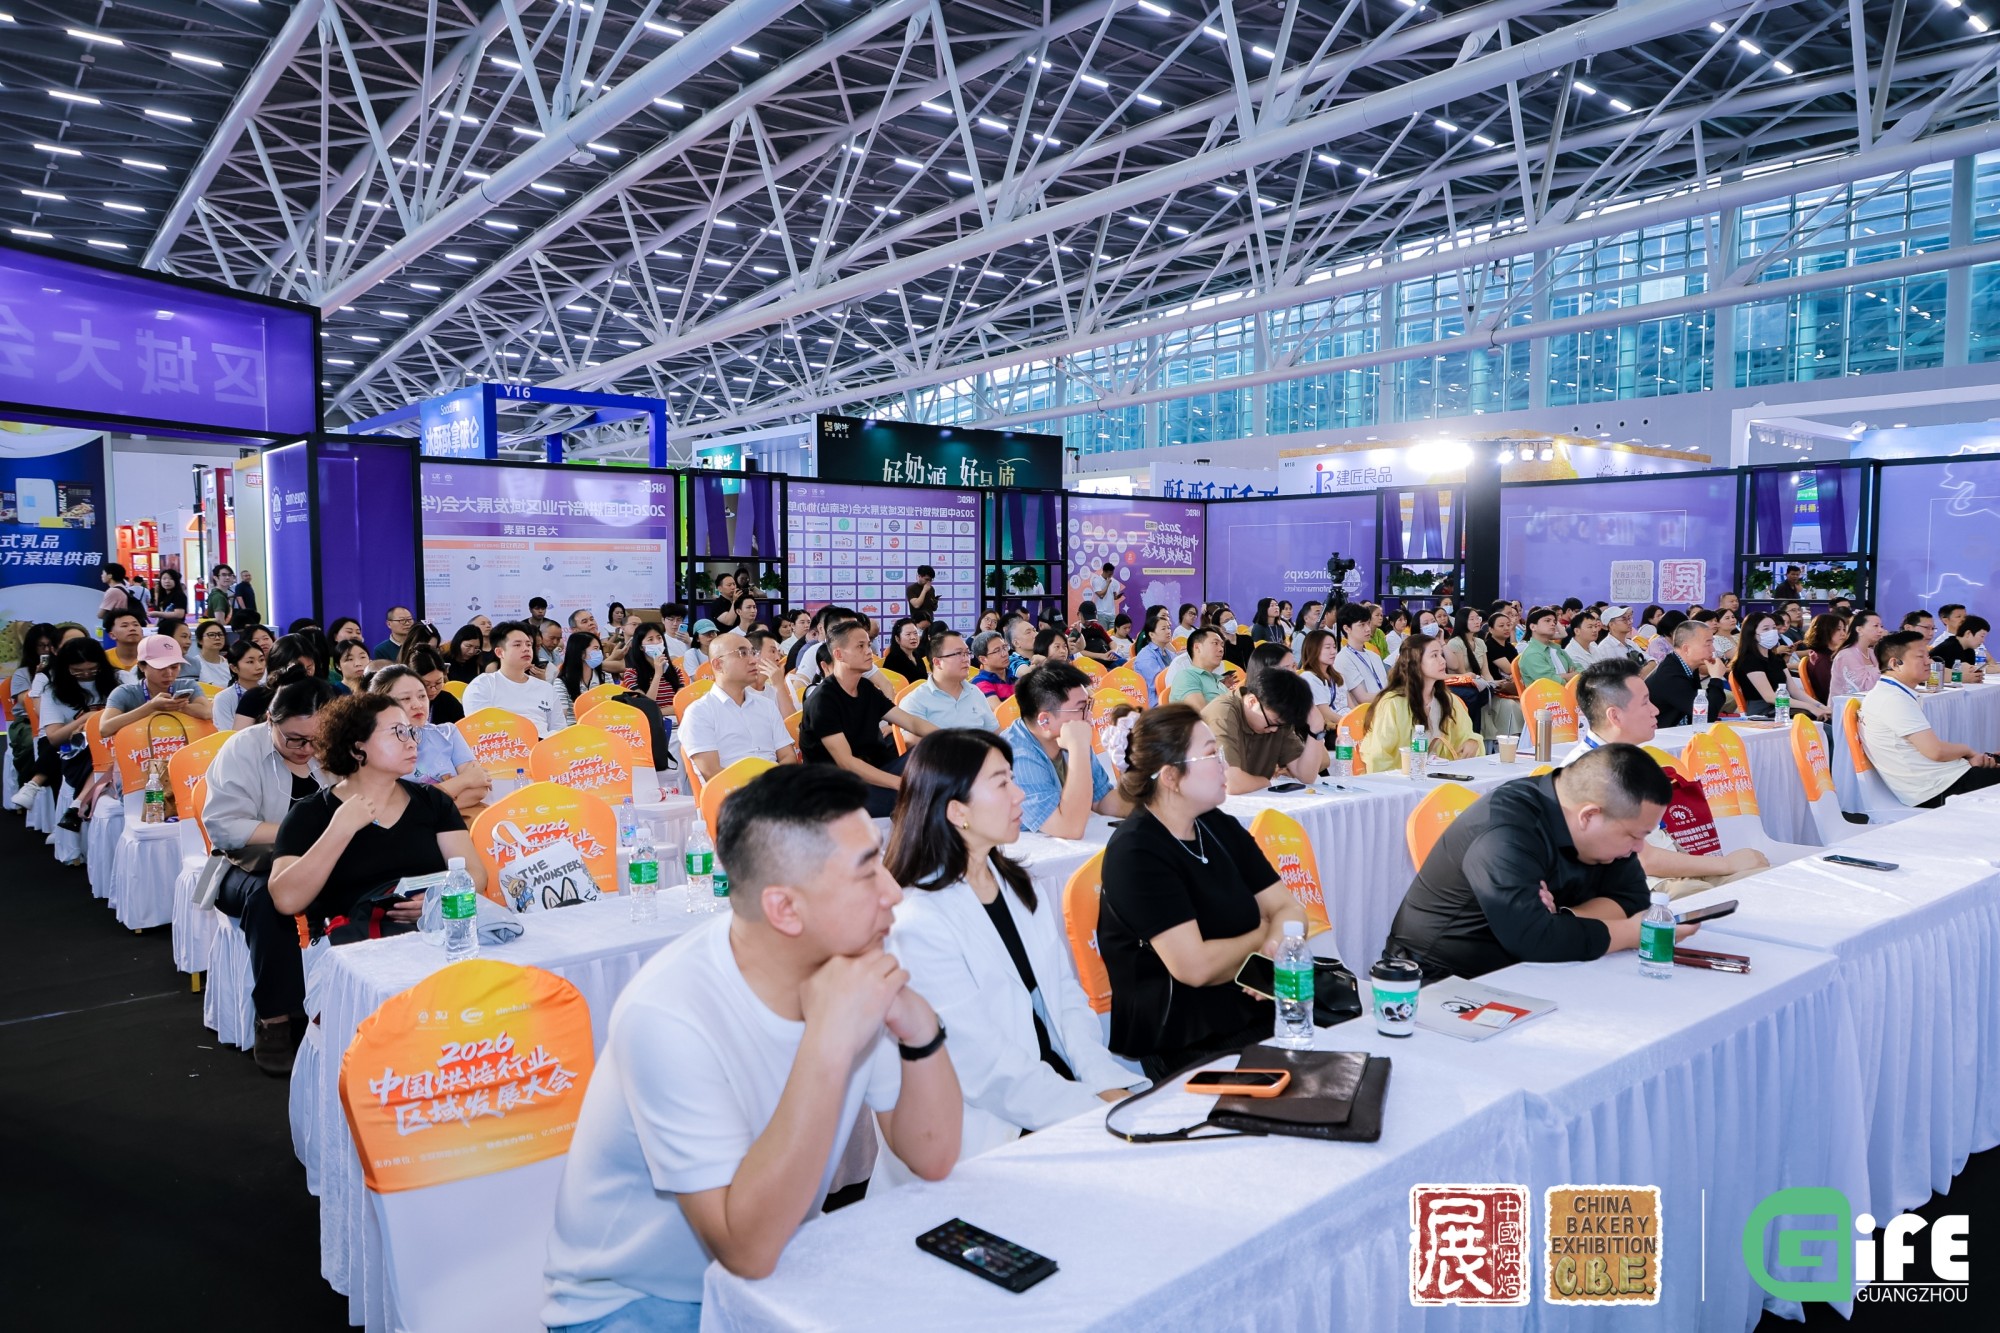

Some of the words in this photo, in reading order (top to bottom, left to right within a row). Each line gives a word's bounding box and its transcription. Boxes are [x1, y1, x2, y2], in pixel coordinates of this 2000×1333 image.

[504, 385, 531, 398] Y16
[1336, 467, 1393, 487] 建匠良品
[152, 734, 186, 746] 2026
[478, 729, 509, 743] 2026
[569, 754, 603, 770] 2026
[525, 818, 570, 838] 2026
[518, 860, 549, 880] THE
[533, 860, 582, 887] MONSTERS
[436, 1031, 516, 1068] 2026
[368, 1045, 560, 1106] 中国烘焙行业
[395, 1066, 578, 1136] 区域发展大会
